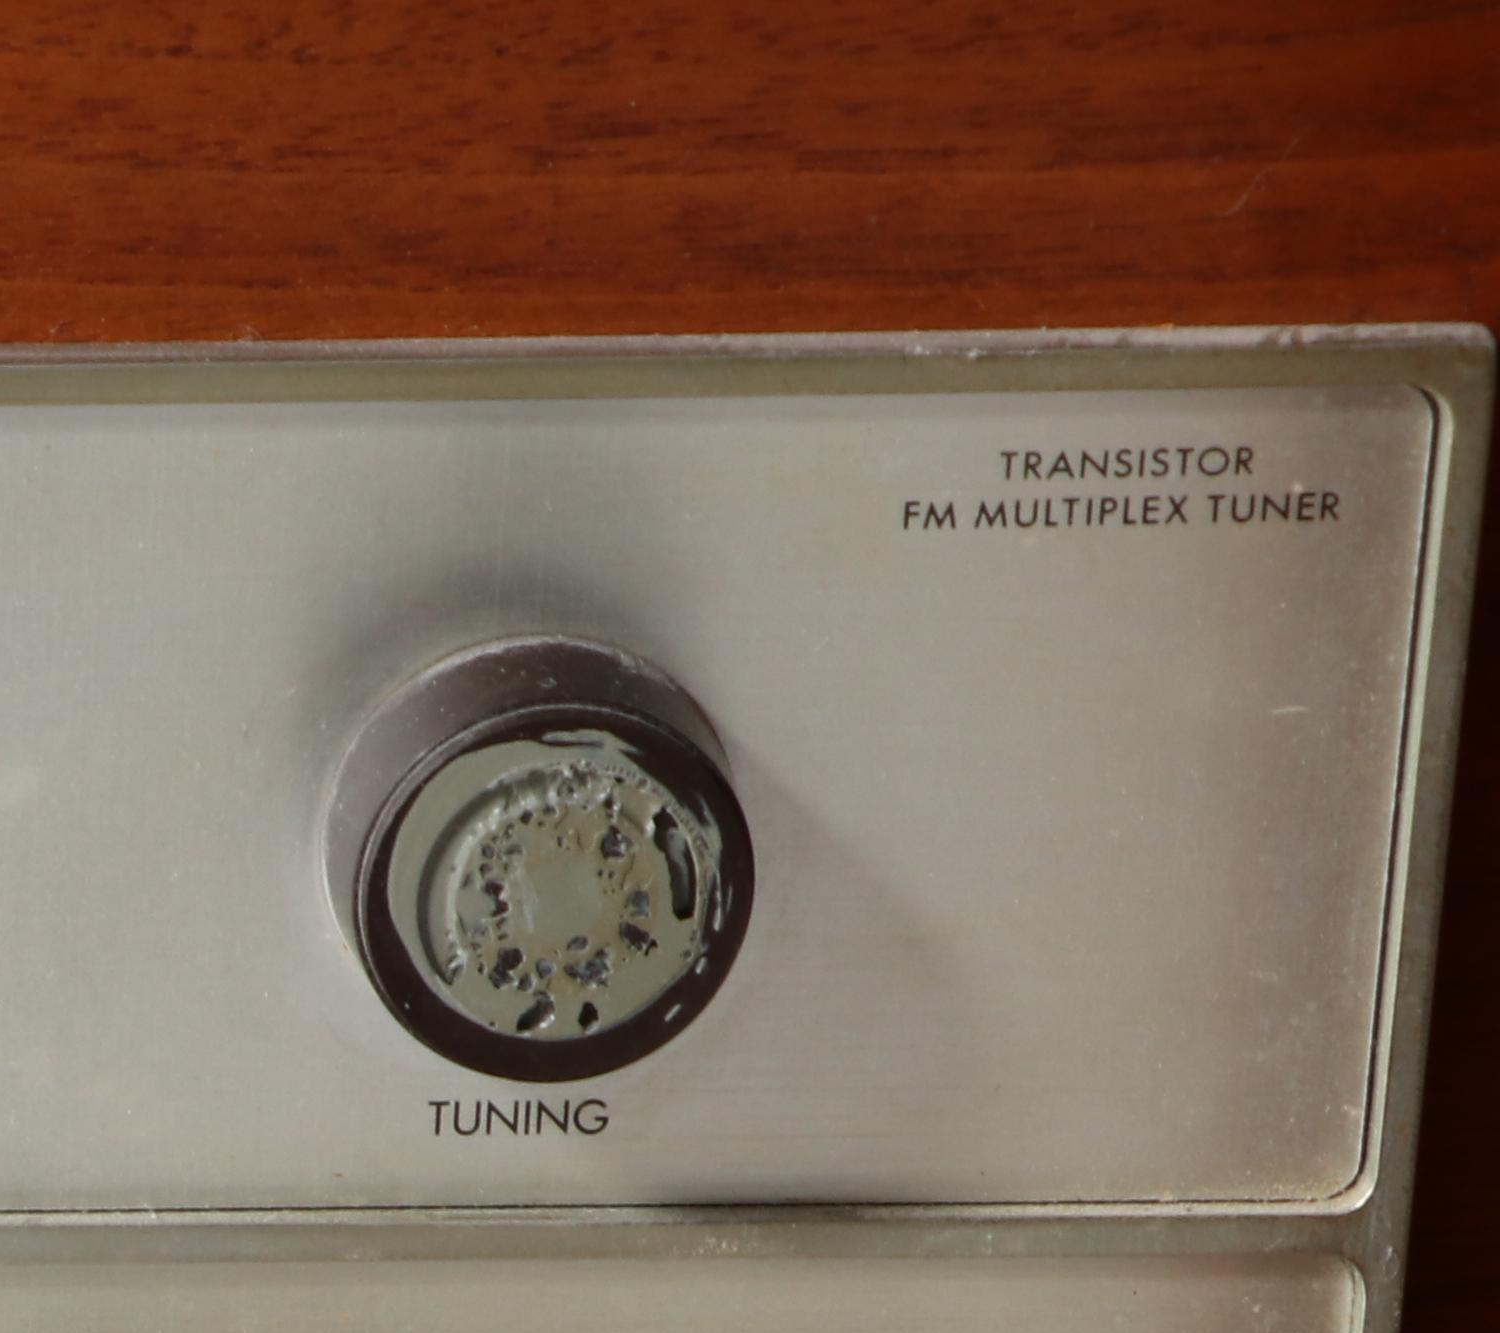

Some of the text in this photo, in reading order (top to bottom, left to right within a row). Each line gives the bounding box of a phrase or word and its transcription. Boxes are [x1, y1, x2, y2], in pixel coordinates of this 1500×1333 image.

[1000, 446, 1254, 480] TRANSISTOR
[903, 488, 1340, 530] FM MULTIPLEX TUNER
[428, 1098, 609, 1136] TUNING
